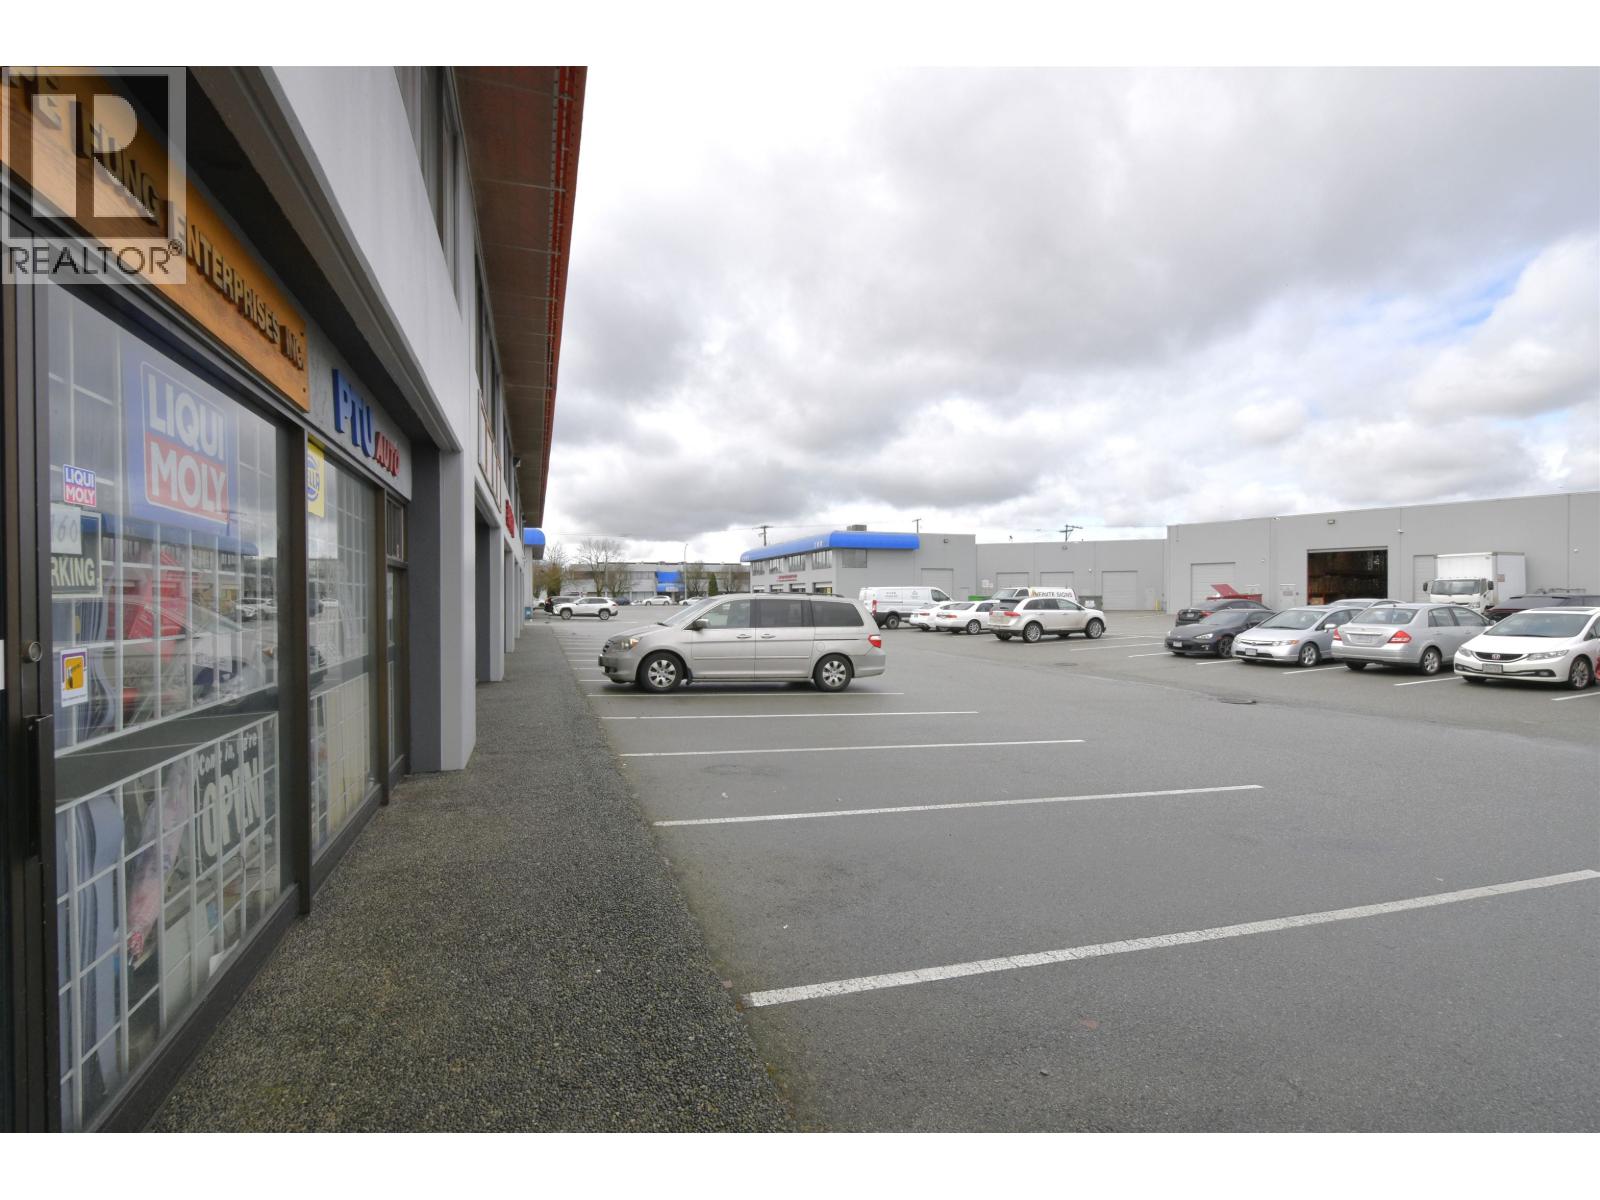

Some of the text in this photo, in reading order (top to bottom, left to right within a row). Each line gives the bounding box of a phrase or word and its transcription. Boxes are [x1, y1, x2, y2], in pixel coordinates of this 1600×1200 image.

[148, 374, 224, 460] LIQUI
[65, 467, 95, 487] LIQUI
[151, 441, 226, 512] MOLY
[373, 431, 401, 477] AUTO
[66, 486, 95, 504] MOLY
